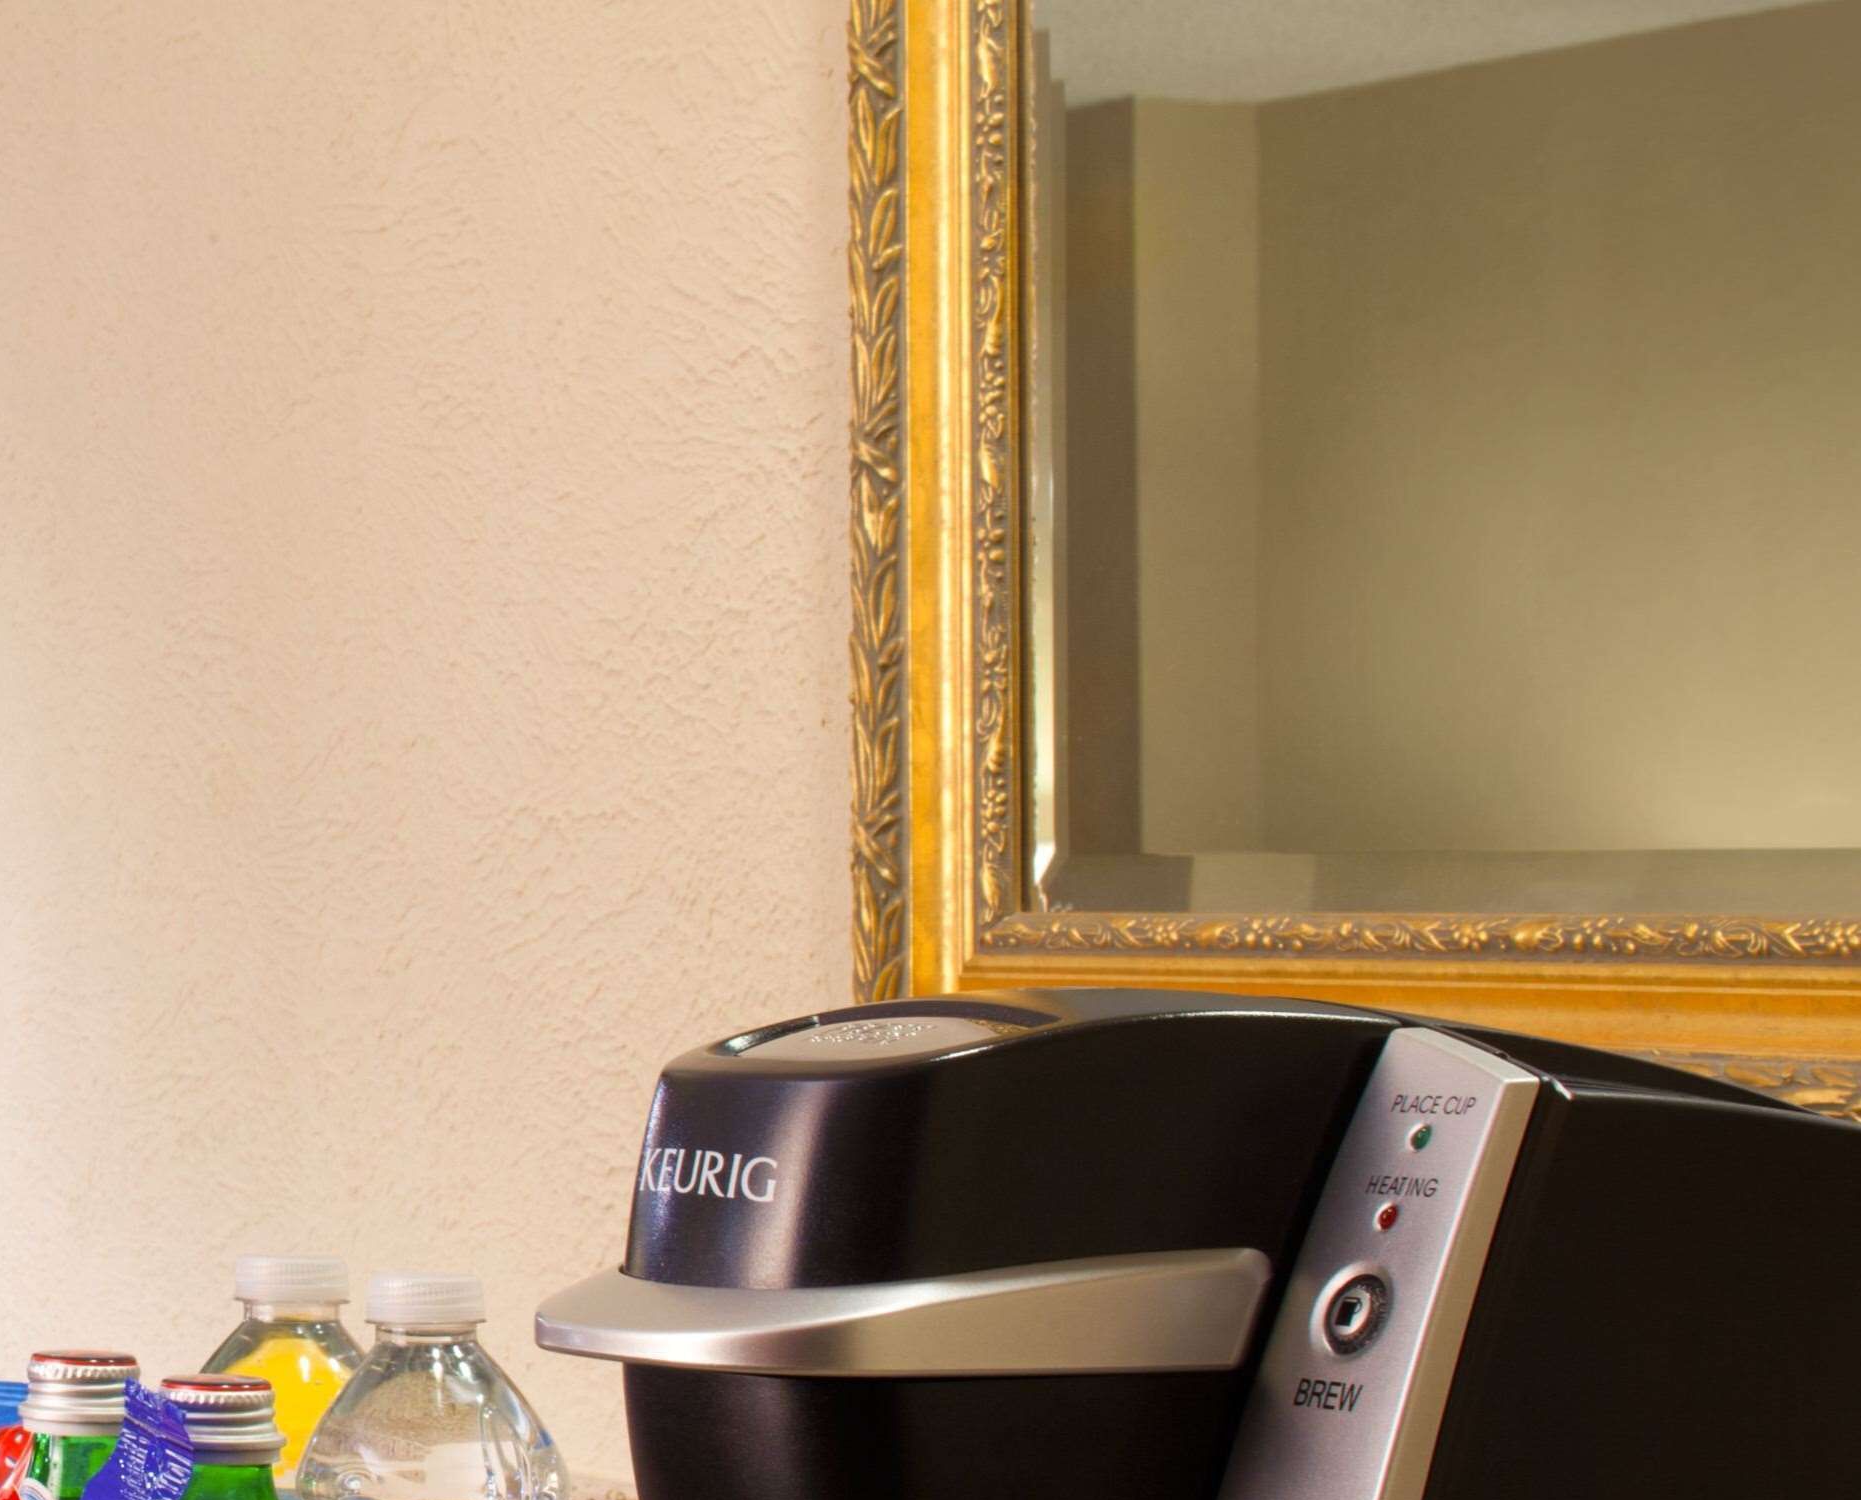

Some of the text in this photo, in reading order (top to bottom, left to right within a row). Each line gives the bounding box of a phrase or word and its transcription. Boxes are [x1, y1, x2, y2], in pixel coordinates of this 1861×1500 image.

[1390, 1094, 1477, 1115] PLACE CUP
[640, 1147, 779, 1202] KEURIG
[1365, 1175, 1439, 1198] HEATING
[1293, 1378, 1364, 1412] BREW
